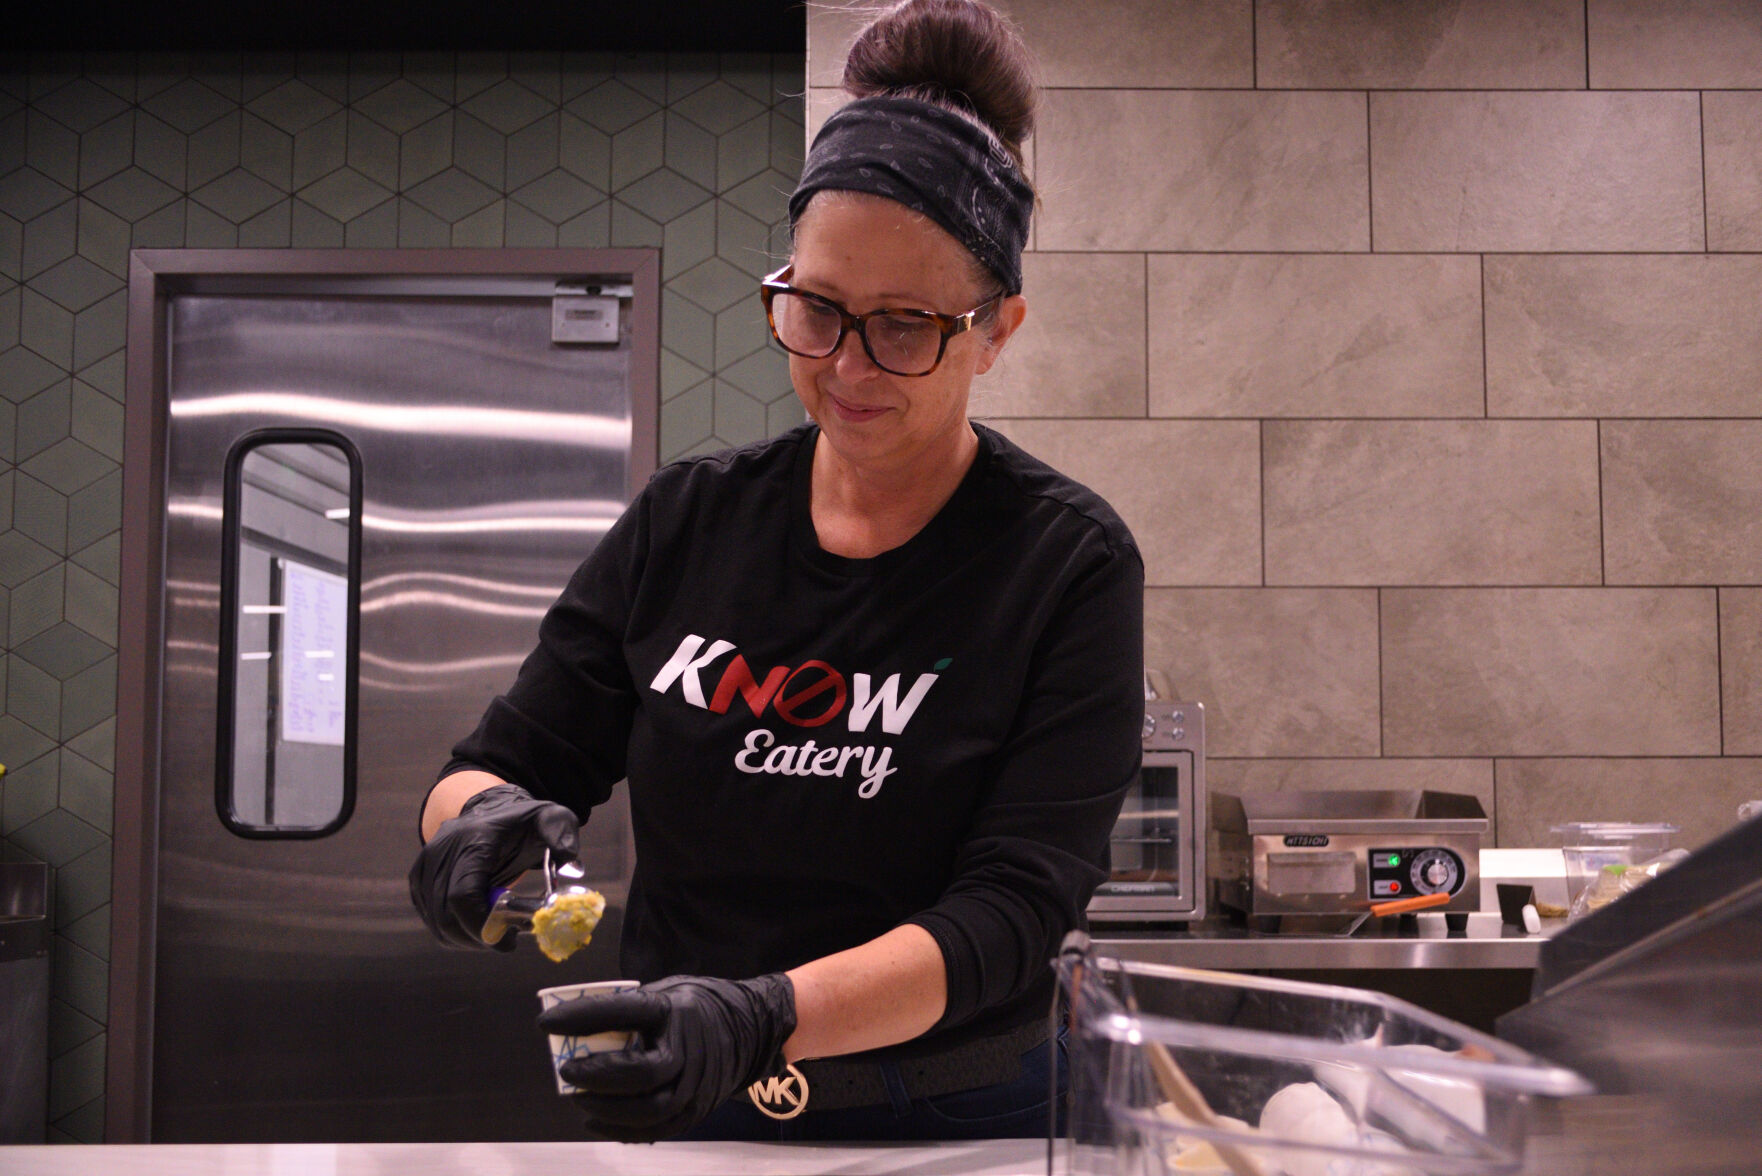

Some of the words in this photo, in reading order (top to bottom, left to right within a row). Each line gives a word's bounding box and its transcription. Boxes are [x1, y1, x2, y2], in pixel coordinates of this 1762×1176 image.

[650, 634, 939, 735] KNOW
[735, 729, 898, 799] Eatery
[753, 1076, 800, 1106] MK
